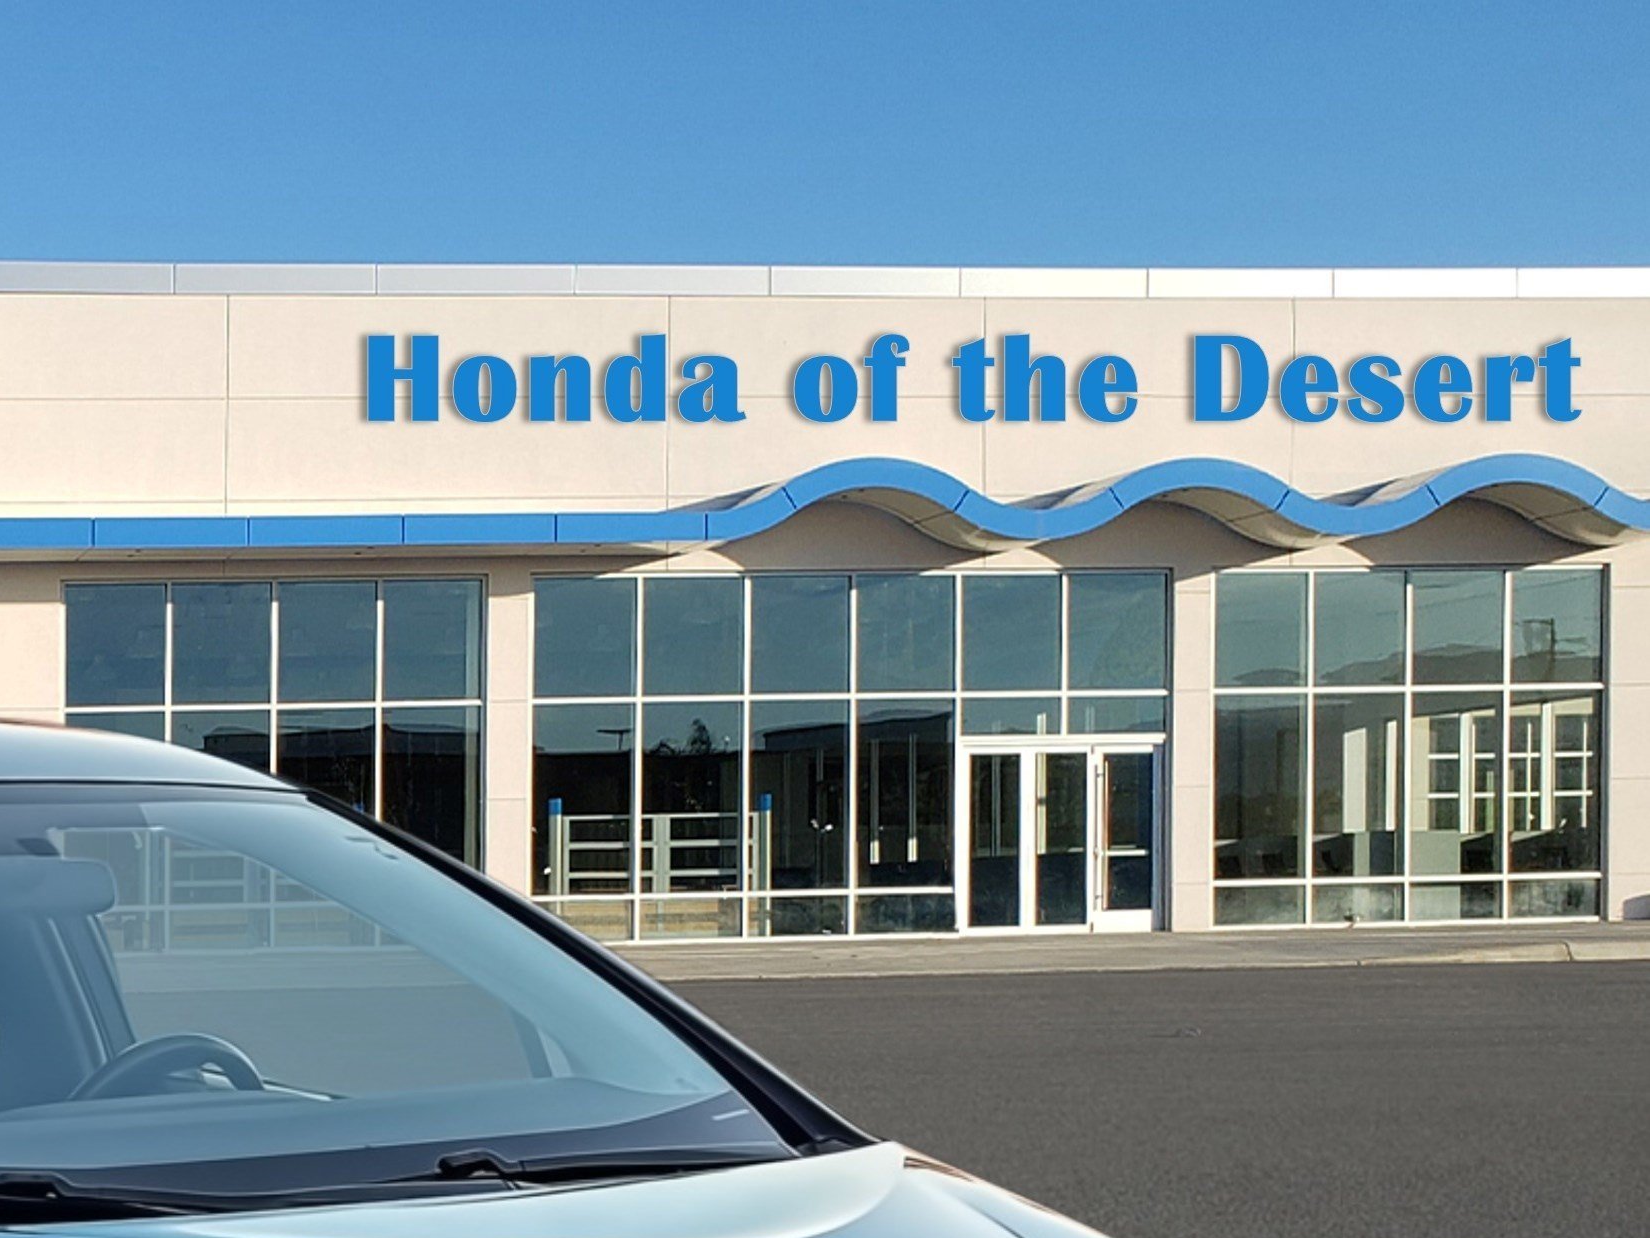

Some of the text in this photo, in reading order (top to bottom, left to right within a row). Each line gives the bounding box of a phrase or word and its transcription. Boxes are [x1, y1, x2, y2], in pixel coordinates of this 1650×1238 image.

[366, 333, 1583, 424] Honda of the Desert
